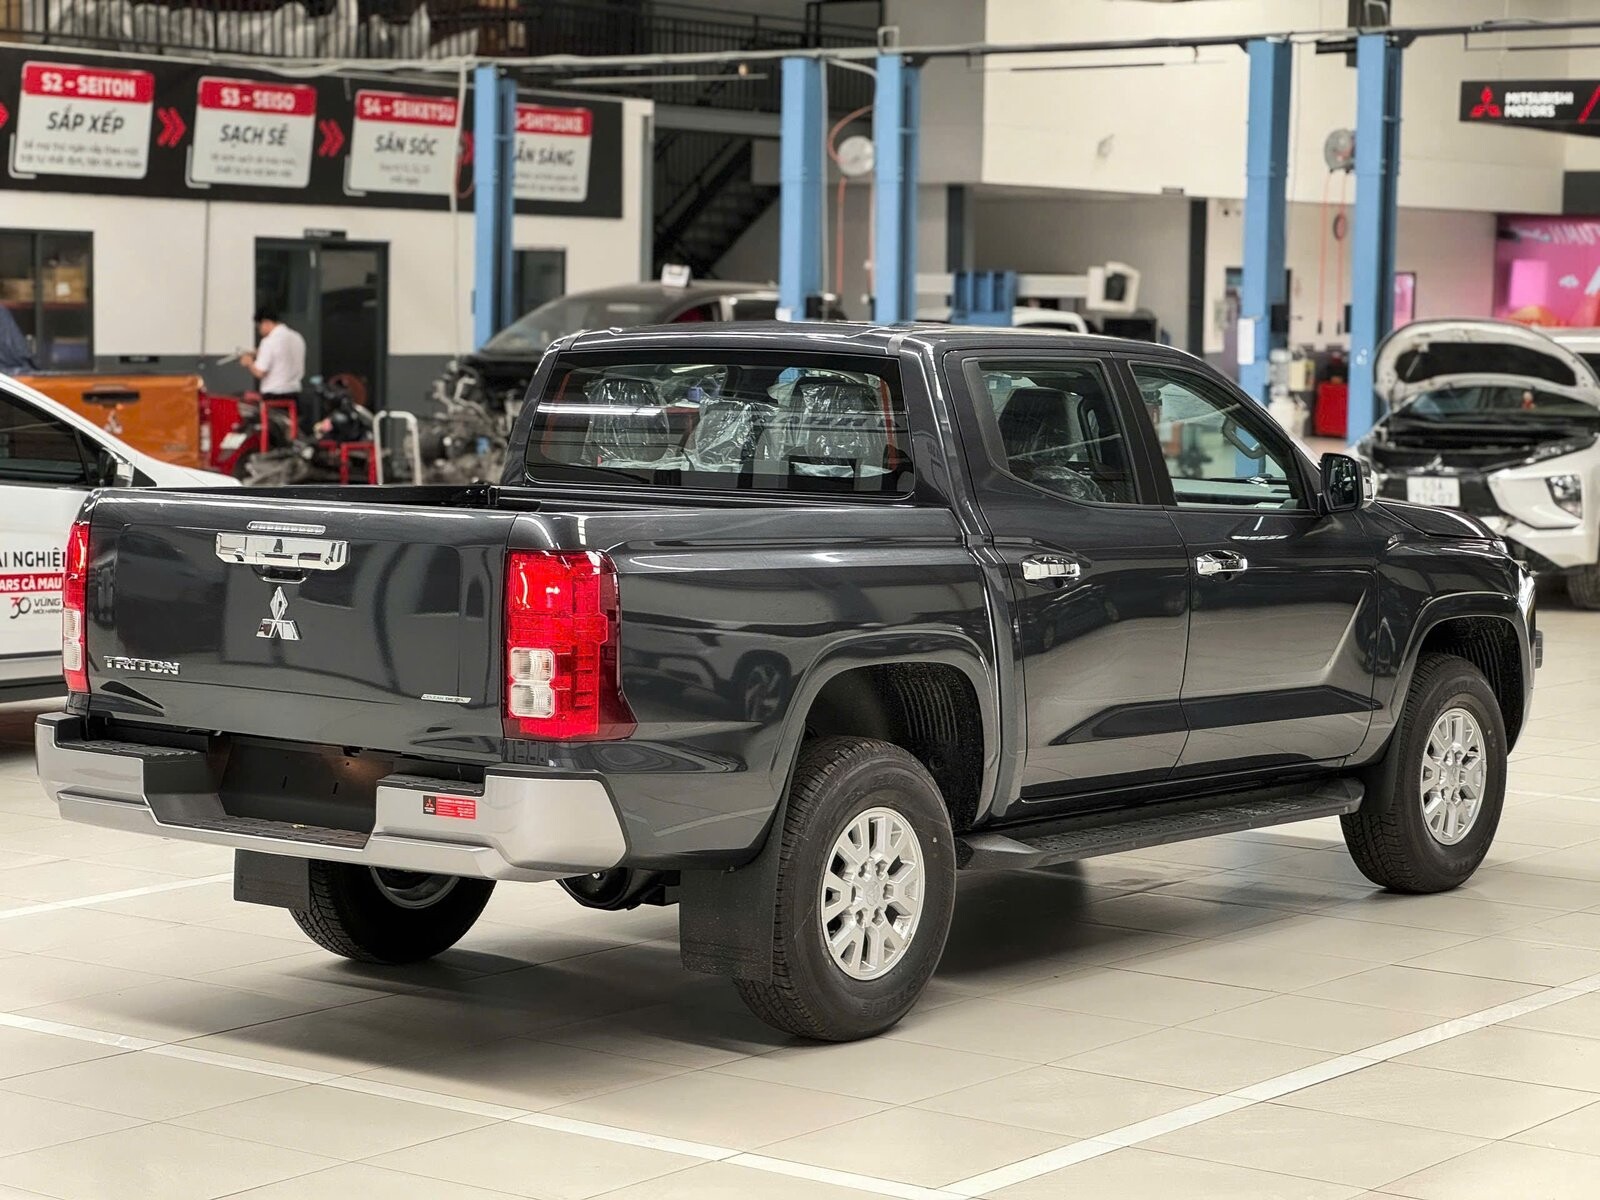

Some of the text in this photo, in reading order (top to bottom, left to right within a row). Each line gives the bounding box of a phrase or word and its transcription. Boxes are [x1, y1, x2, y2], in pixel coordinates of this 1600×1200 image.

[41, 71, 63, 93] S2
[77, 74, 137, 98] SEITON
[220, 86, 240, 107] S3
[253, 89, 296, 112] SEISO
[1504, 104, 1555, 118] MOTORS
[87, 107, 125, 134] XẾP
[220, 123, 264, 149] SẠCH
[21, 575, 36, 591] CÀ
[37, 576, 63, 590] MAU
[103, 655, 180, 675] TRITON
